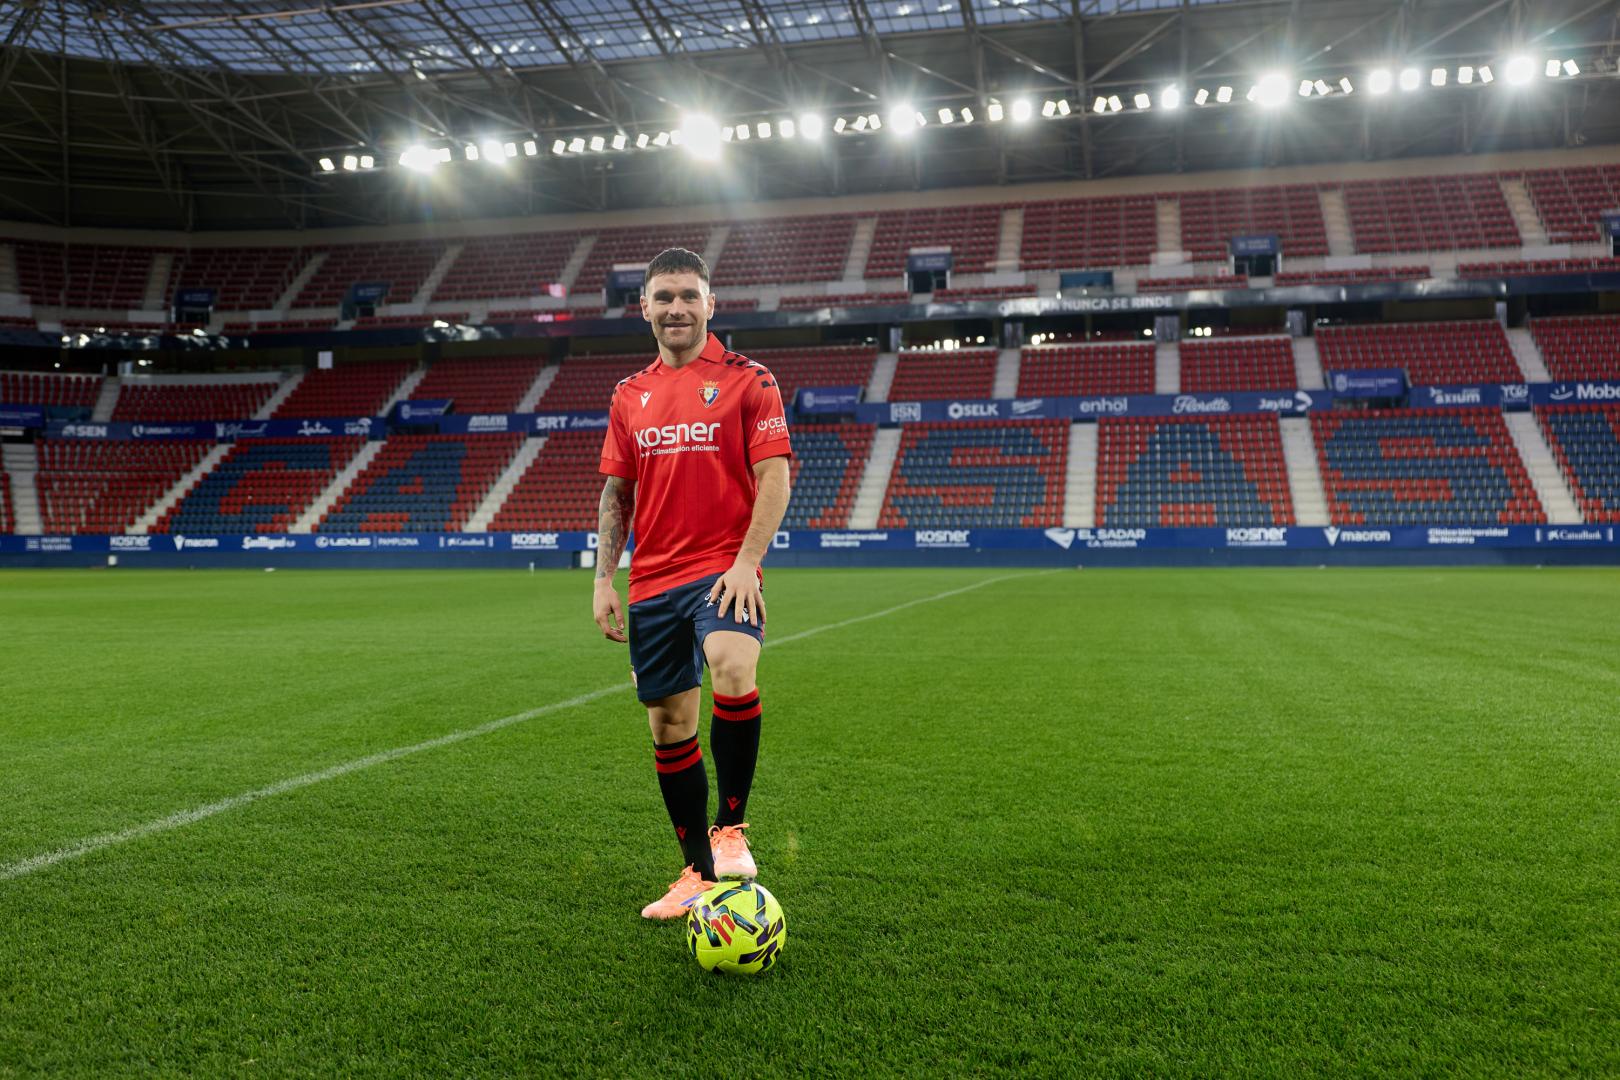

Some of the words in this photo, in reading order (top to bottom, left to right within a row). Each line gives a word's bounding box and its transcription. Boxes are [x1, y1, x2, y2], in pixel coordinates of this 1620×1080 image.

[1132, 296, 1173, 308] RINDE
[963, 404, 998, 417] SELK
[536, 416, 568, 430] SRT
[691, 444, 720, 452] eficiente
[1078, 529, 1096, 540] EL
[1097, 529, 1146, 540] SADAR
[1340, 530, 1391, 541] macron
